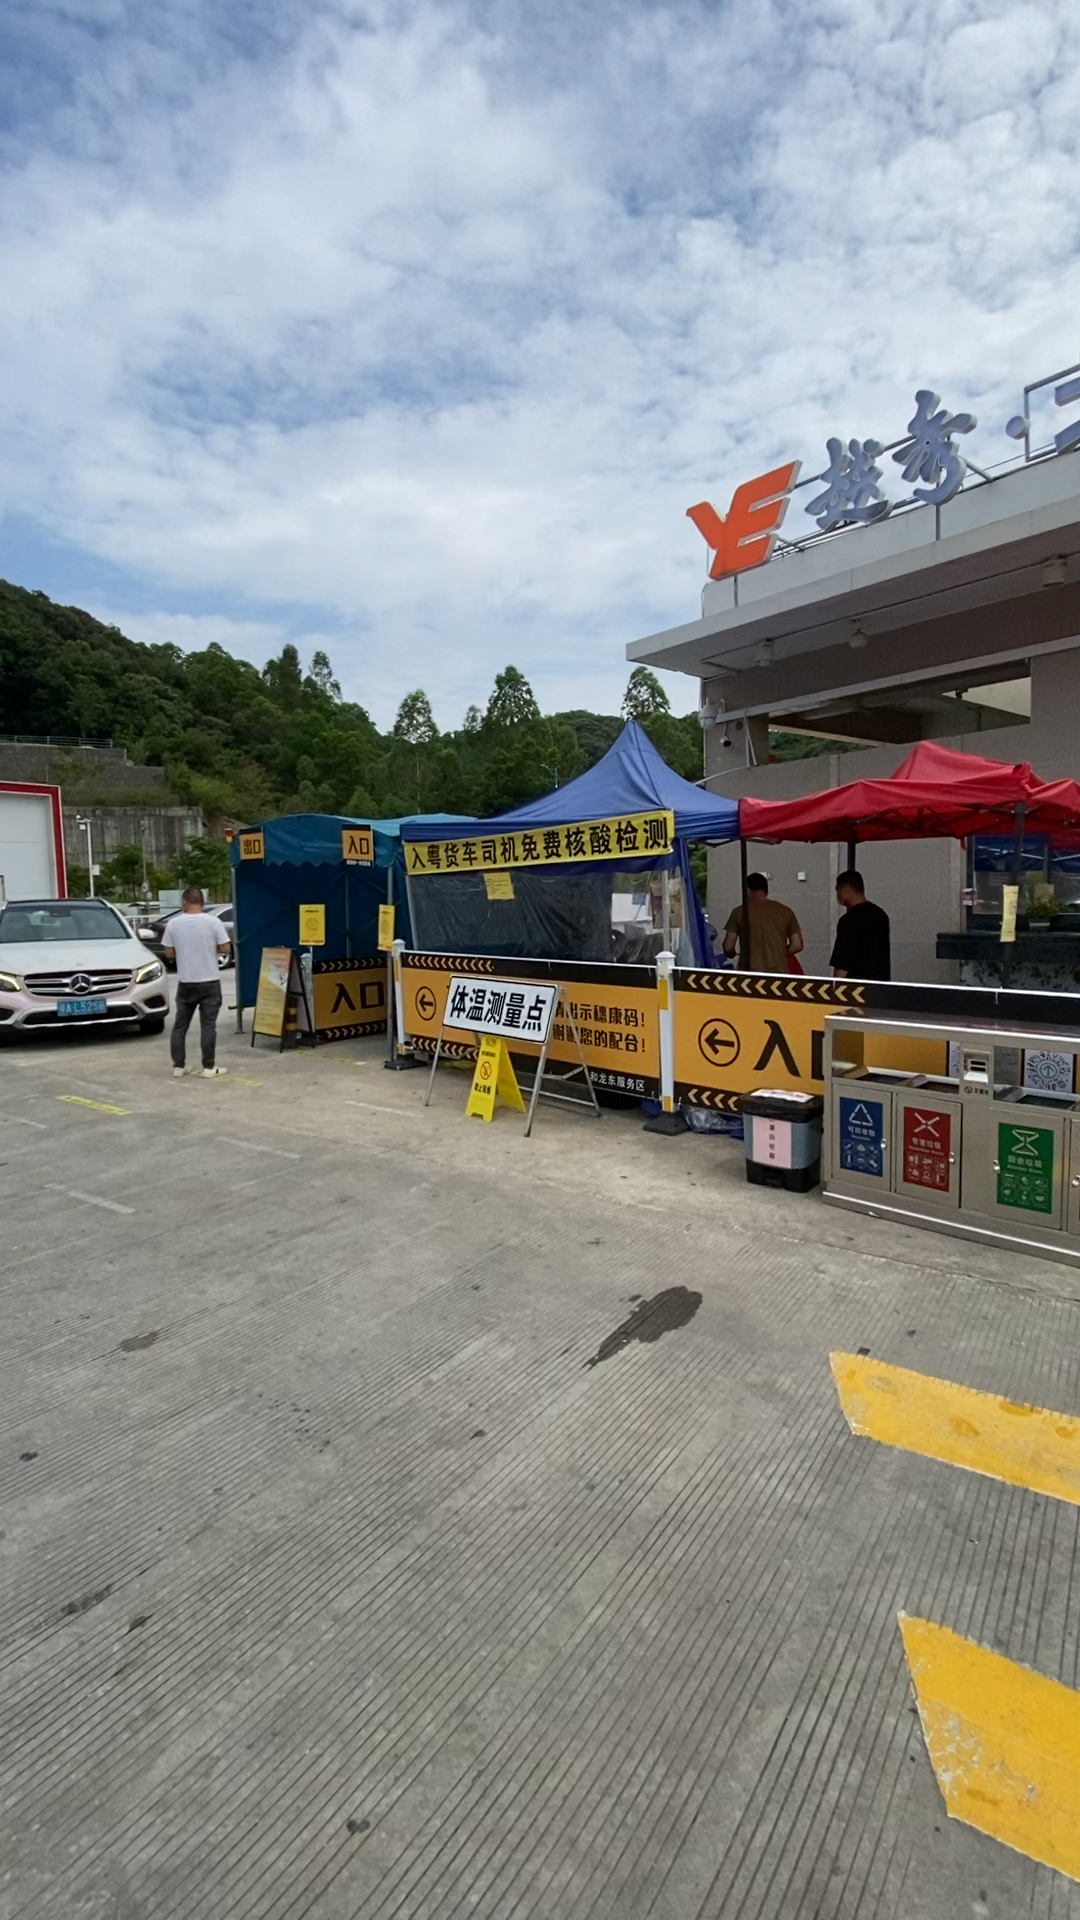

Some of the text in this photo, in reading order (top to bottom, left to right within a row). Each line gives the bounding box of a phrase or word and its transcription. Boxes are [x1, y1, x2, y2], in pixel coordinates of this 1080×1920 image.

[348, 835, 370, 855] 入口
[411, 817, 669, 870] 入粤货车司机免费核酸检测
[331, 981, 384, 1014] 入口
[450, 984, 547, 1032] 体温测量点
[753, 1019, 825, 1081] 入
